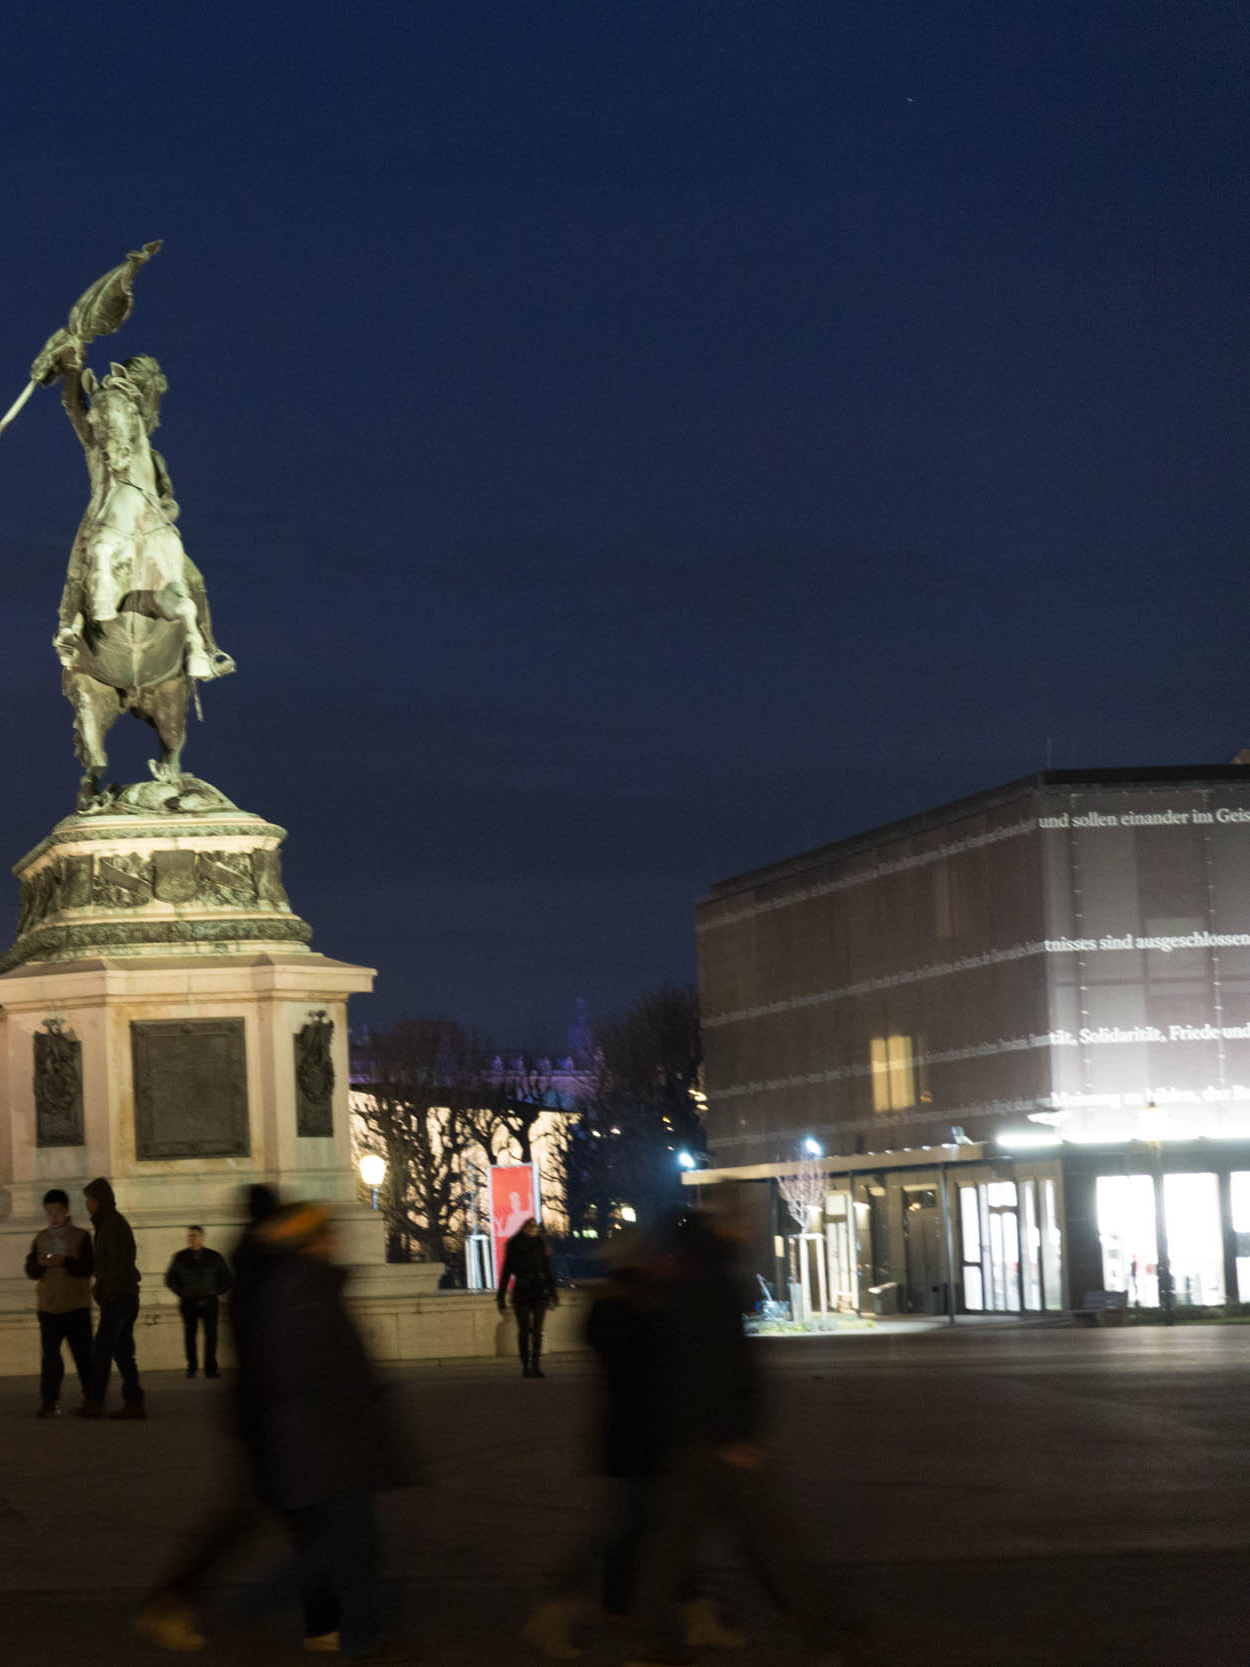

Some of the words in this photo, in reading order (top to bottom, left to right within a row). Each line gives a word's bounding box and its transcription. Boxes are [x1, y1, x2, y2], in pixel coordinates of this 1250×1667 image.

[1038, 812, 1069, 829] und
[1071, 811, 1119, 828] sollen
[1121, 810, 1190, 826] einander
[1192, 809, 1214, 824] im
[1099, 934, 1133, 950] sind
[1136, 931, 1250, 952] ausgeschlossen
[1079, 1026, 1168, 1045] Solidarität,
[1169, 1023, 1221, 1041] Friede
